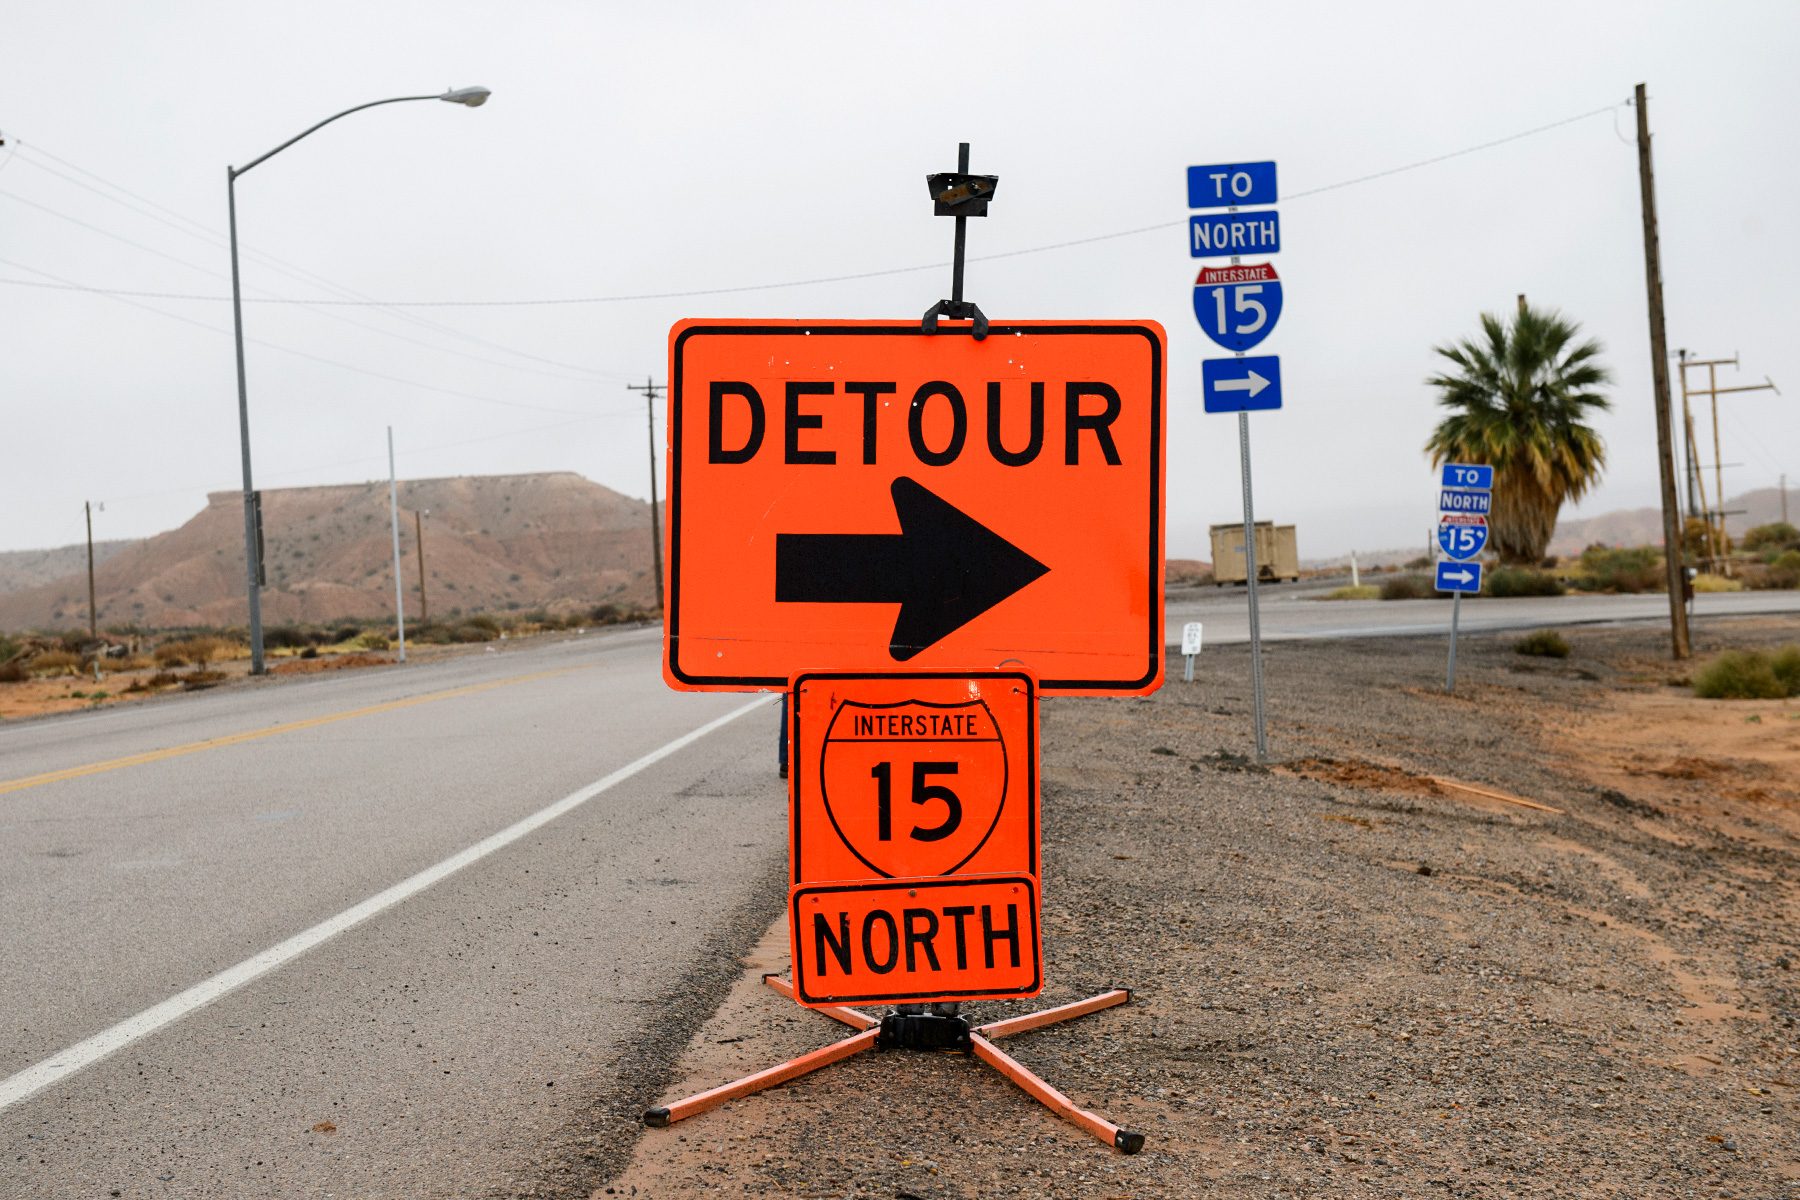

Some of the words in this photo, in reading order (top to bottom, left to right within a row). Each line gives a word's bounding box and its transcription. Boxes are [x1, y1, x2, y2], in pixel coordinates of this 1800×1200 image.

[1210, 172, 1252, 198] TO
[1194, 221, 1276, 249] NORTH
[1205, 268, 1268, 283] INTERSTATE
[1212, 285, 1267, 335] 15
[708, 380, 1122, 467] DETOUR
[1455, 469, 1479, 484] TO
[1442, 493, 1488, 510] NORTH
[1449, 529, 1475, 551] 15
[854, 715, 978, 736] INTERSTATE
[871, 762, 963, 842] 15
[813, 904, 1021, 977] NORTH
